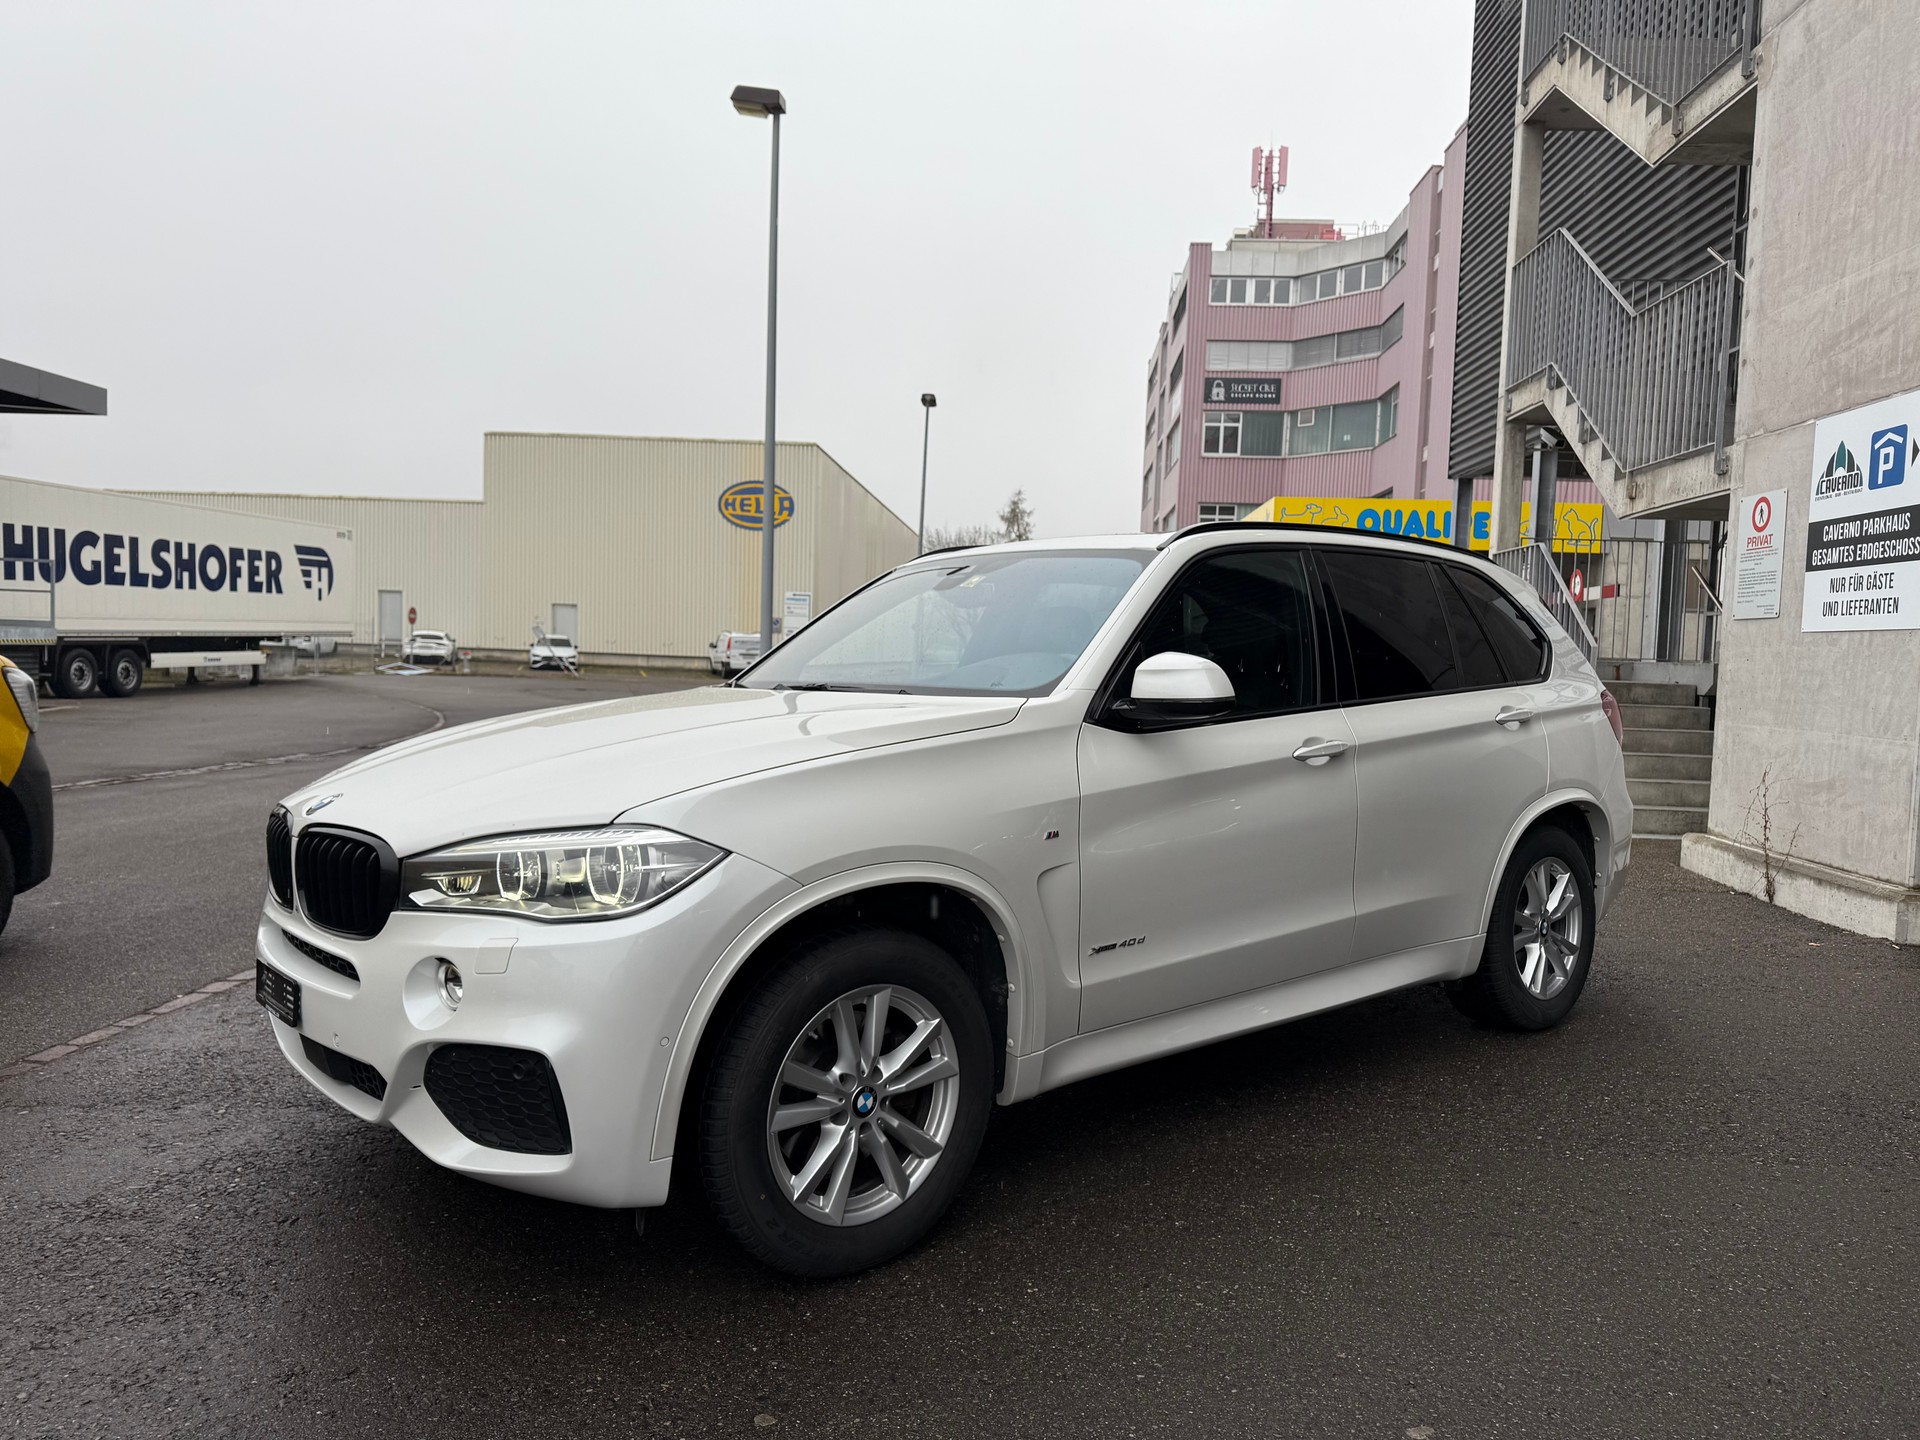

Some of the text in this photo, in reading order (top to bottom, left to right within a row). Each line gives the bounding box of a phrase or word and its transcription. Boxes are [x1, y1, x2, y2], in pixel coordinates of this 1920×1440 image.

[1877, 445, 1895, 485] P
[1820, 472, 1860, 495] CAVERNO
[724, 496, 795, 518] HELA
[1823, 512, 1911, 542] CAVERNO PARKHAUS
[1746, 533, 1774, 549] PRIVAT
[1811, 536, 1920, 567] GESAMTES ERDGESCHOSS
[2, 523, 283, 594] HUGELSHOFER
[1829, 571, 1895, 594] NUR FÜR GÄSTE
[1822, 597, 1900, 618] UND LIEFERANTEN
